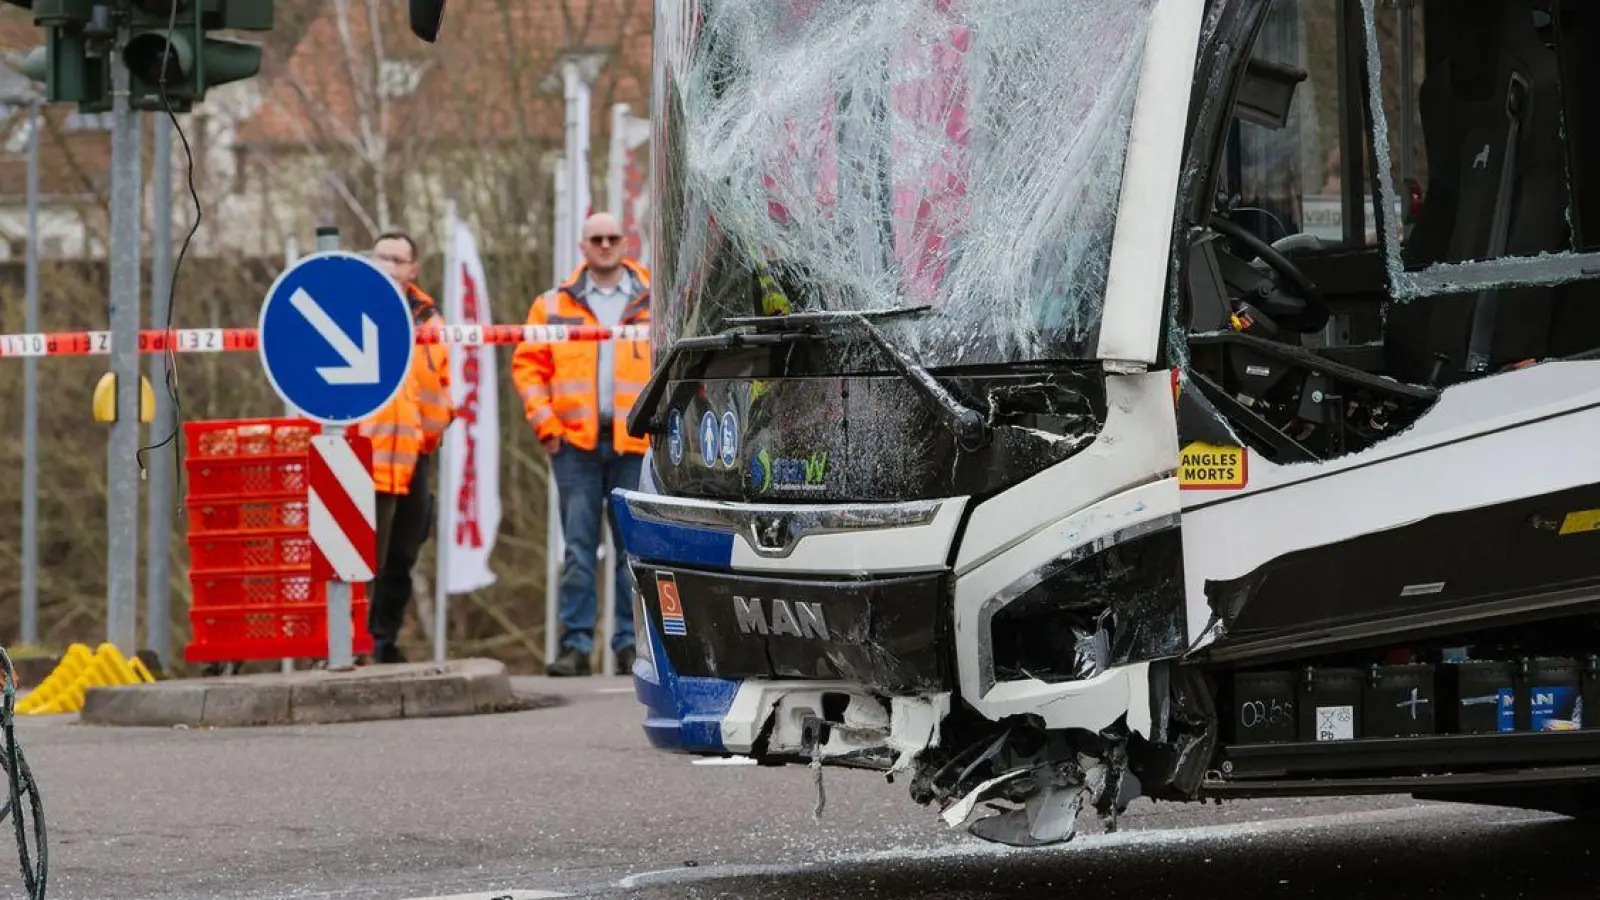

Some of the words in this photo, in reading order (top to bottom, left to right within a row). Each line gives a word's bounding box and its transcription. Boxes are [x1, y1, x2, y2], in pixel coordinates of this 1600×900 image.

[1182, 453, 1237, 466] ANGLES
[1185, 468, 1235, 480] MORTS
[733, 595, 831, 641] MAN
